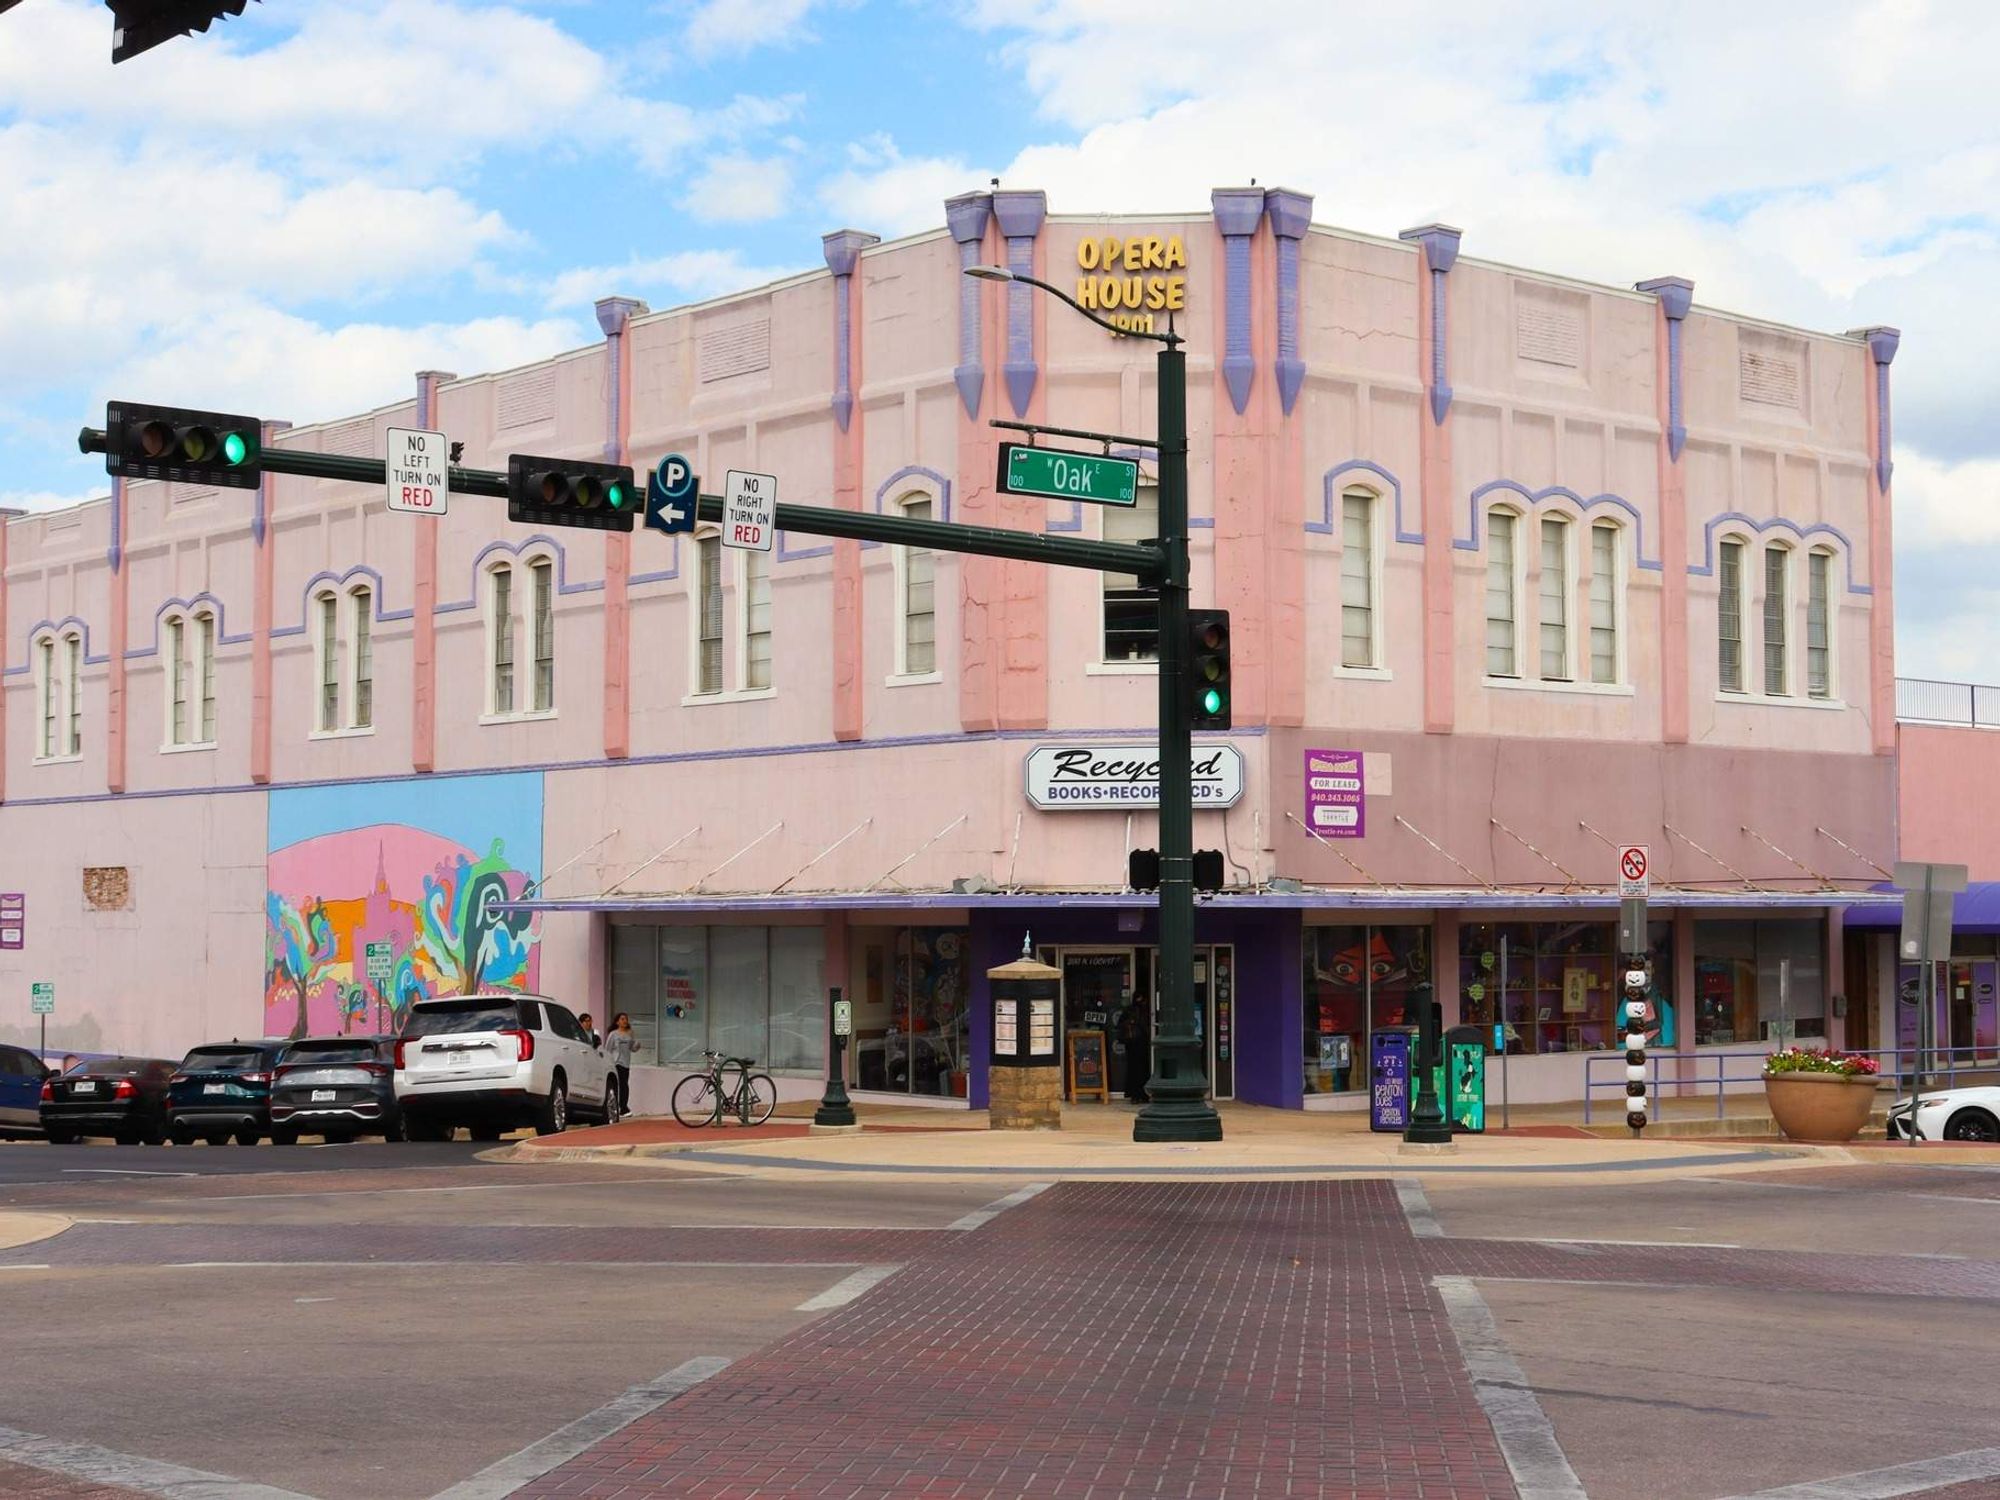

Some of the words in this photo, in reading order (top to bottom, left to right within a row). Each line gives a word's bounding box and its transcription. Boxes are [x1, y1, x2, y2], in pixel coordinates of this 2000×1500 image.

[1078, 236, 1186, 272] OPERA
[1077, 275, 1184, 311] HOUSE
[408, 436, 426, 451] NO
[404, 454, 430, 468] LEFT
[393, 469, 421, 484] TURN
[427, 473, 441, 486] ON
[666, 462, 685, 488] P
[1010, 475, 1024, 486] 100
[1047, 457, 1053, 468] W
[1053, 459, 1093, 493] Oak
[1095, 464, 1101, 474] E
[1125, 466, 1134, 476] St
[743, 478, 759, 493] NO
[1119, 488, 1132, 499] 100
[402, 487, 433, 507] RED
[737, 495, 763, 509] RIGHT
[729, 509, 753, 522] TURN
[756, 513, 769, 525] ON
[734, 525, 760, 544] RED
[1053, 750, 1222, 784] Recycd
[1314, 779, 1330, 788] FOR
[1333, 779, 1357, 789] LEASE
